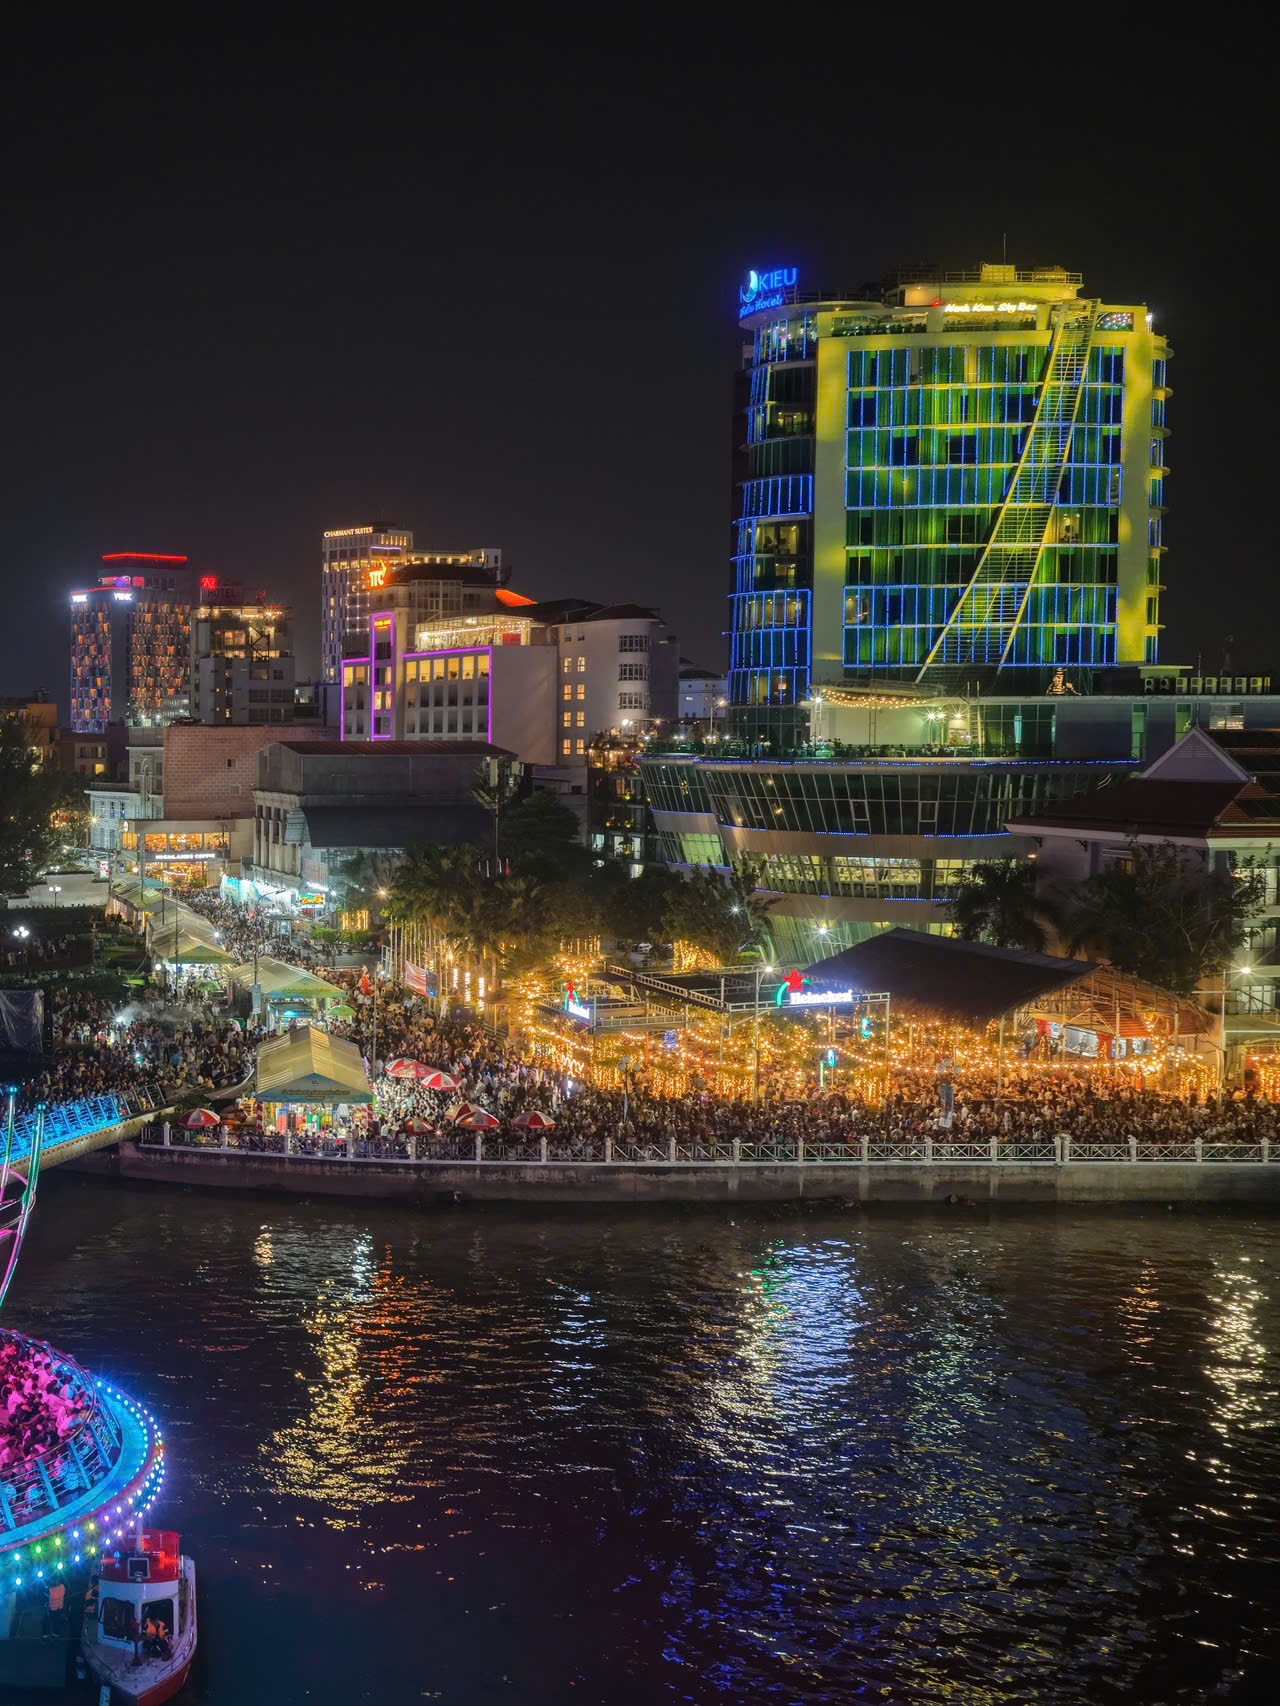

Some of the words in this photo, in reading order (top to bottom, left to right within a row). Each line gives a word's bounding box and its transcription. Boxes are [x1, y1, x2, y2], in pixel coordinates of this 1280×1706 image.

[323, 528, 355, 538] CHARMANT
[354, 526, 373, 535] SUITES
[368, 568, 385, 588] TTC
[790, 989, 854, 1005] Heineken
